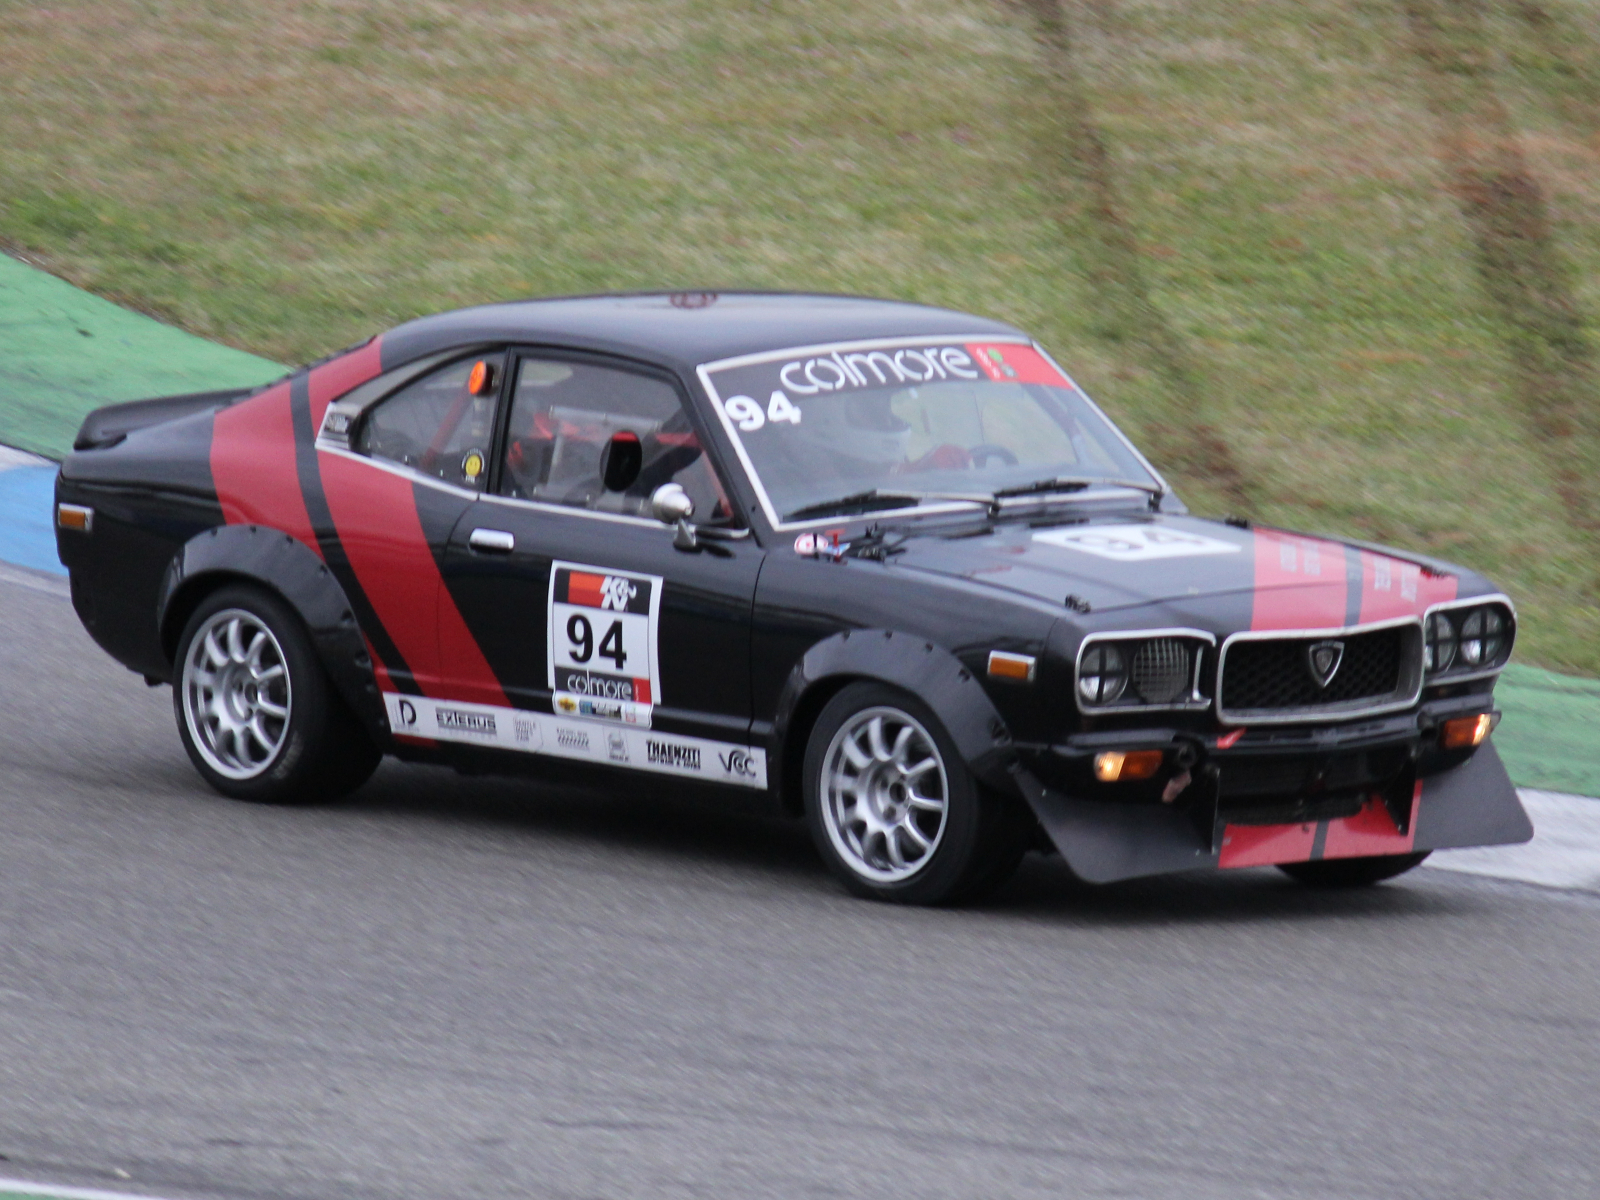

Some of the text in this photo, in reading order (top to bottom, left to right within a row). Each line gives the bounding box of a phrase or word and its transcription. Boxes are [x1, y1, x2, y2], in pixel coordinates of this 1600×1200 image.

[780, 347, 978, 394] colmore
[725, 390, 801, 431] 94
[567, 614, 627, 670] 94
[567, 668, 632, 700] colmore
